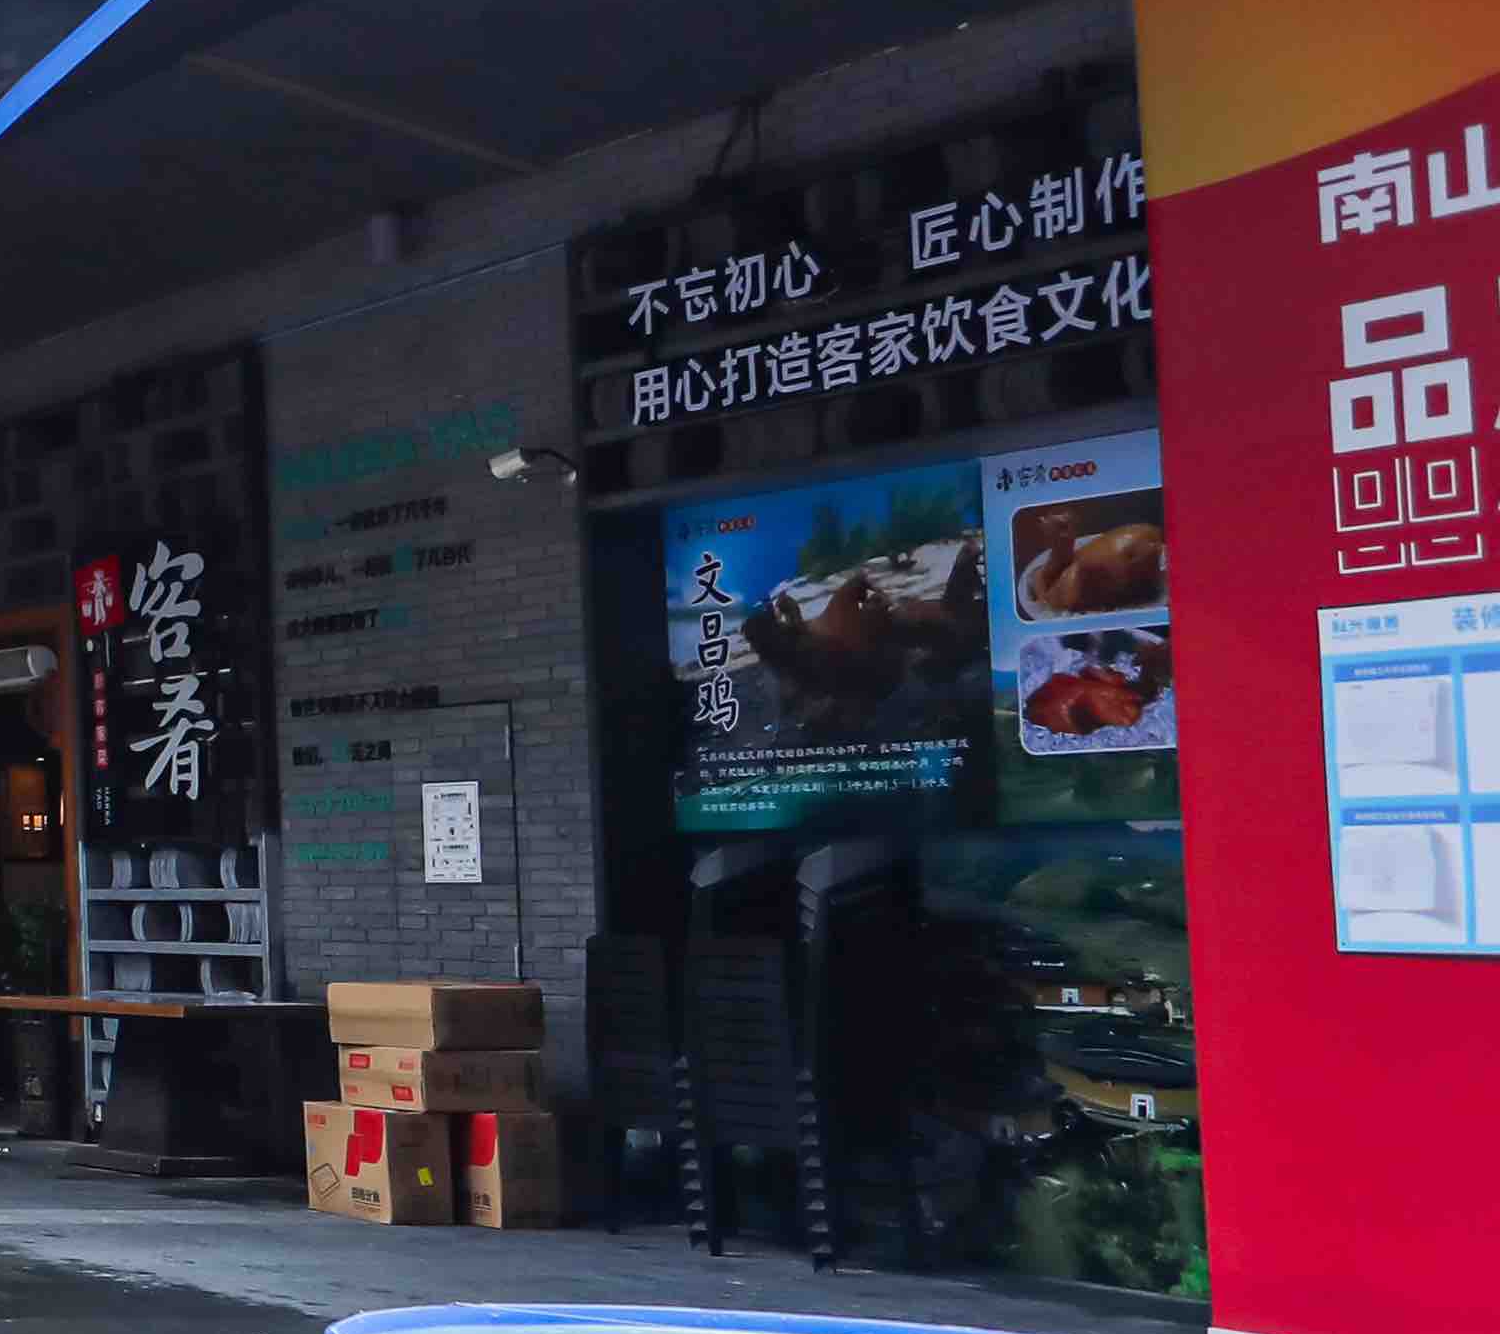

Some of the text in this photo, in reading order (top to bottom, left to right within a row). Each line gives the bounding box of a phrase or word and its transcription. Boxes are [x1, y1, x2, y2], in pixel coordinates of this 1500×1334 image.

[627, 151, 1145, 336] 不忘初心 匠心制作
[631, 255, 1153, 426] 用心打造客家饮食文化
[690, 551, 740, 733] 文昌鸡
